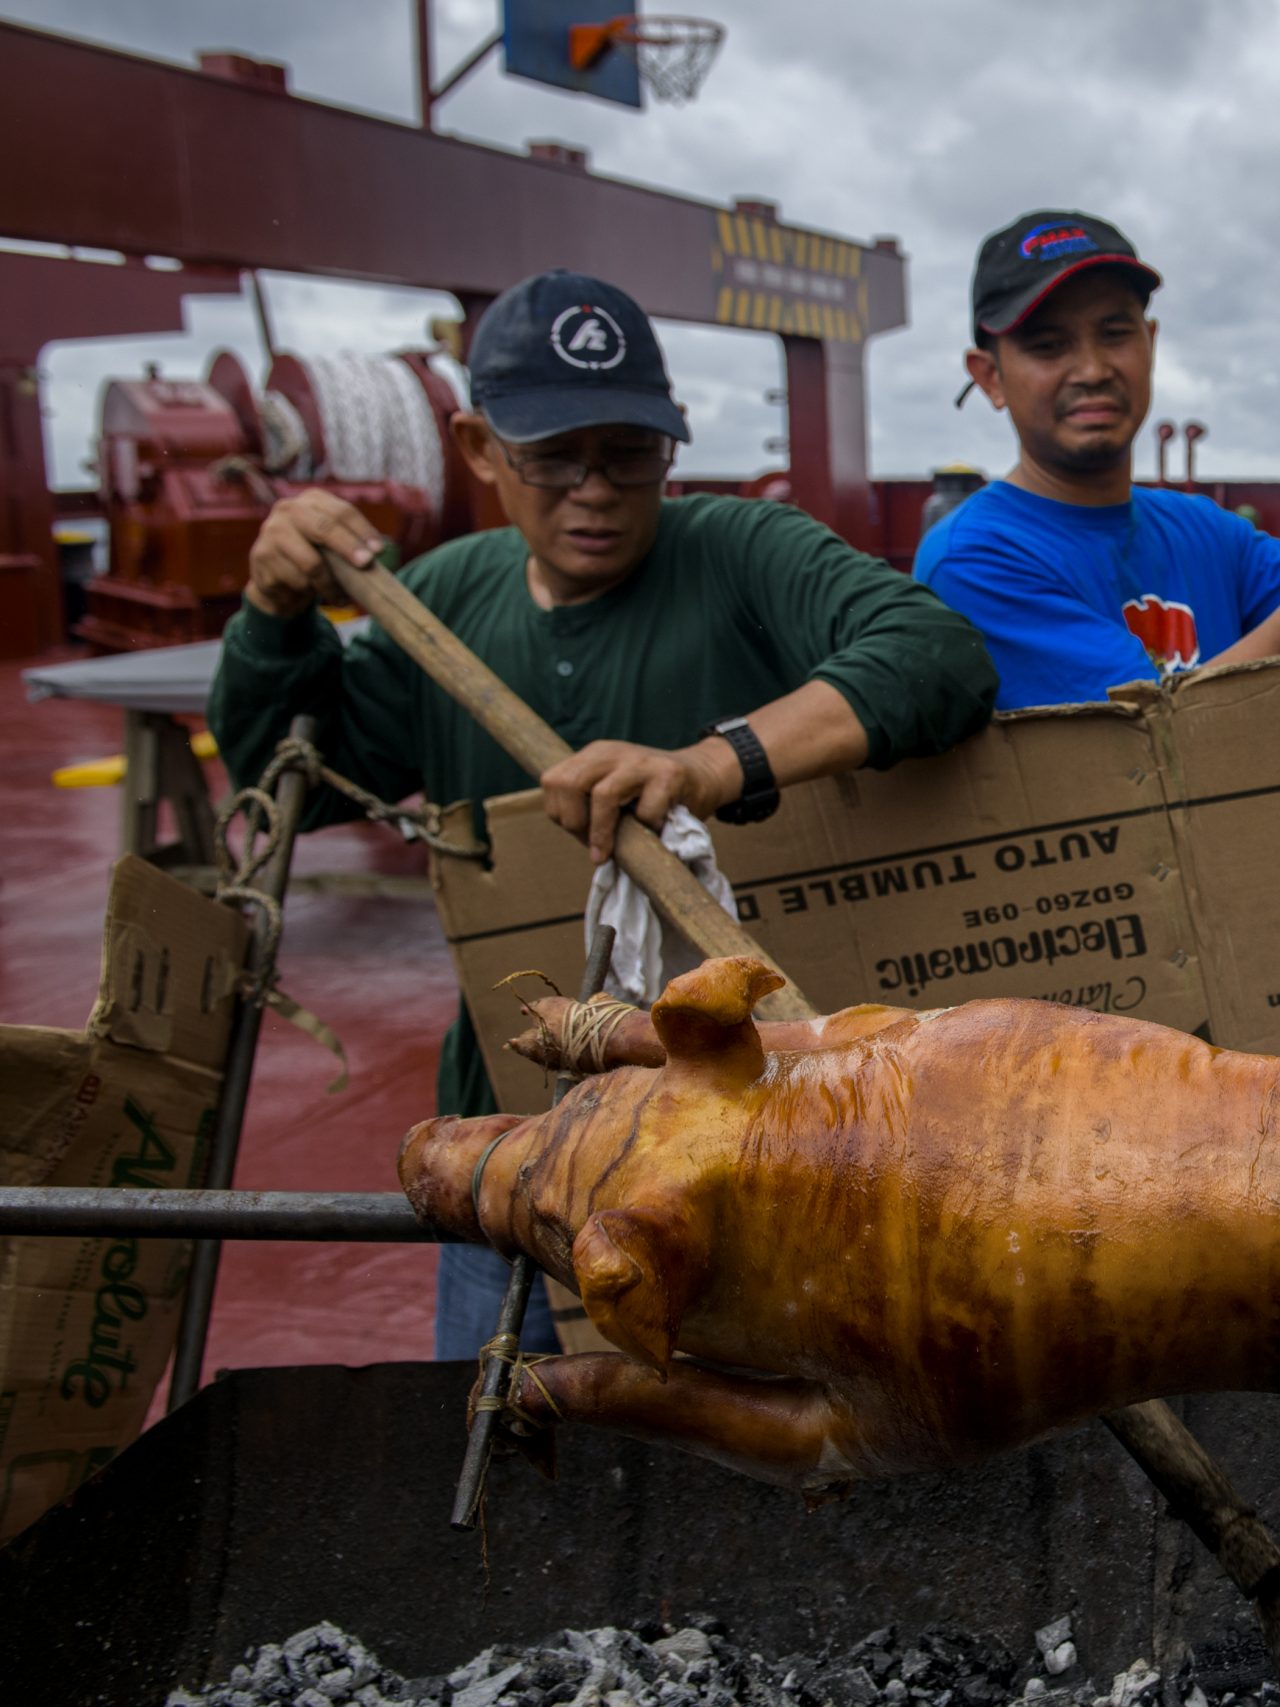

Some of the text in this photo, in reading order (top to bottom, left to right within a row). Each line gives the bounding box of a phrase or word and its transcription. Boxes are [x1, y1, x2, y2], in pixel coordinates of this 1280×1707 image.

[994, 826, 1120, 873] AUTO
[778, 855, 976, 915] TUMBLE
[962, 882, 1134, 928] GDZ60-09E
[874, 913, 1148, 998] Electromatic
[1030, 976, 1146, 1012] Clare
[61, 1095, 176, 1408] Aolute
